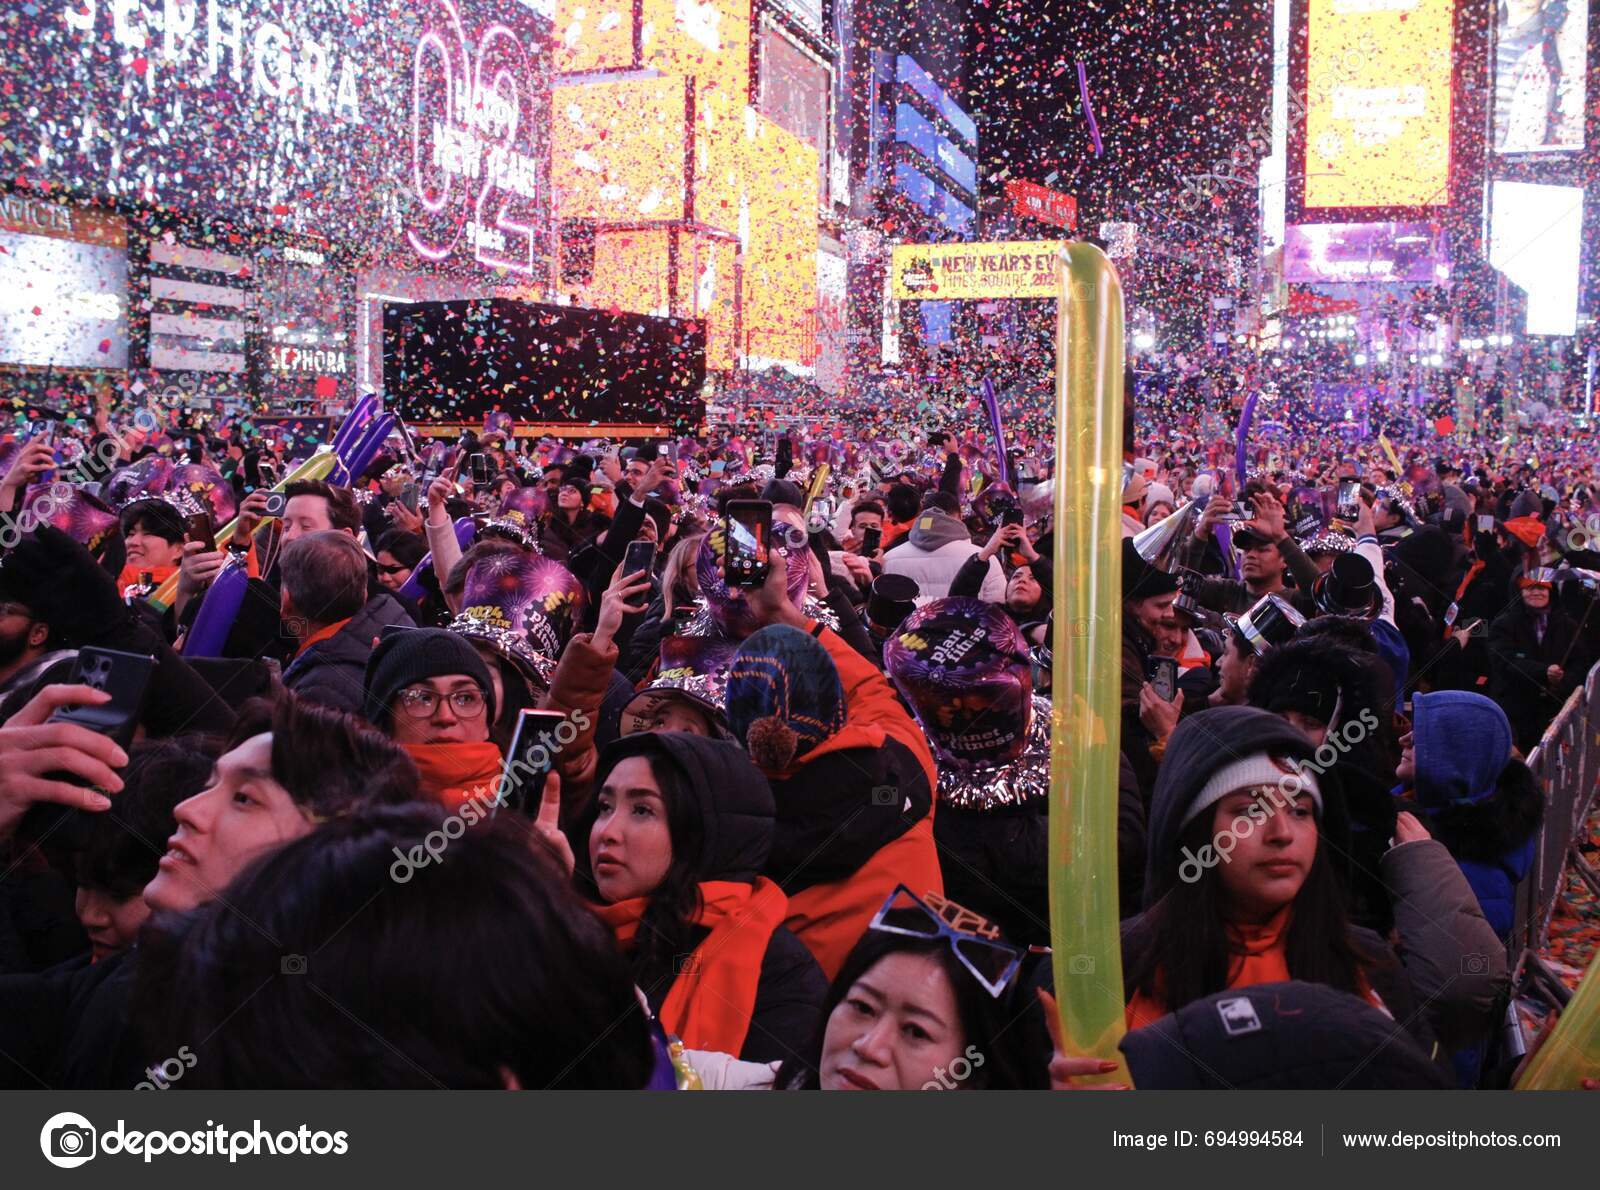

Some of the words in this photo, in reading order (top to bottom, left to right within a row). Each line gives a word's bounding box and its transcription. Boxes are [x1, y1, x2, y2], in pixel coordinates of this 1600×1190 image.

[942, 255, 977, 273] NEW
[1035, 253, 1060, 272] EV
[943, 273, 976, 288] TIMES
[980, 272, 1027, 288] SQUARE
[1030, 272, 1060, 287] 202
[271, 347, 347, 373] SEPHORA
[531, 623, 554, 661] fitne
[923, 889, 999, 940] 2024
